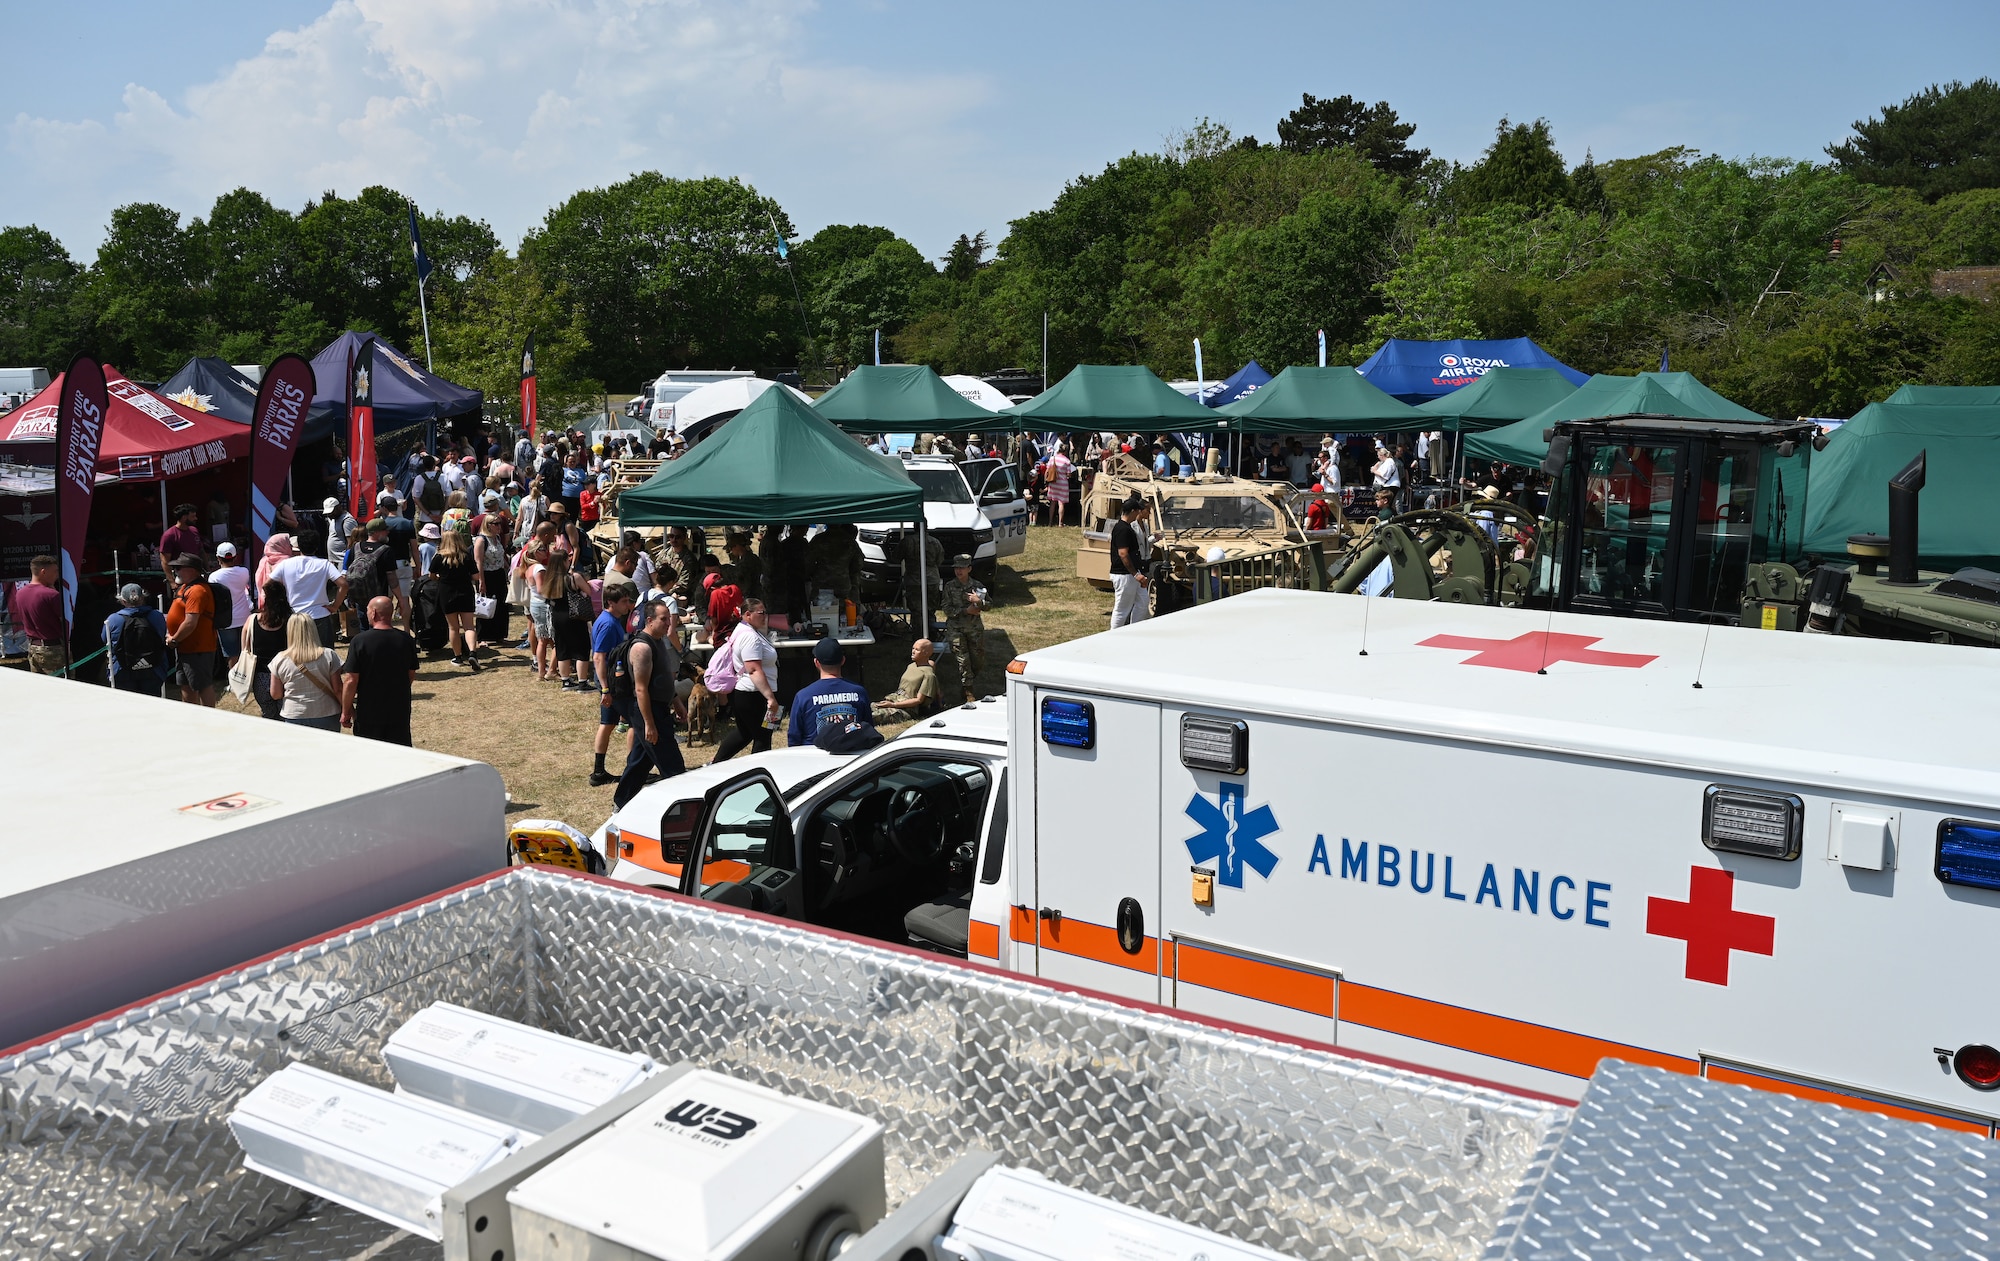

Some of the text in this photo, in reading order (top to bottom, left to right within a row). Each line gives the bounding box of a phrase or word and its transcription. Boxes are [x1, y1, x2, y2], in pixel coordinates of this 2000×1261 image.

[1439, 366, 1492, 378] AIR FOR
[1461, 357, 1510, 367] ROYAL
[1431, 376, 1479, 386] Engin
[259, 378, 287, 440] SUPPORT OUR
[268, 384, 305, 450] PARAS
[65, 389, 84, 480] SUPPORT OUR
[75, 398, 101, 495] PARAS
[192, 444, 209, 466] OUR
[812, 692, 859, 705] PARAMEDIC
[1307, 833, 1612, 928] AMBULANCE
[654, 1121, 731, 1149] WILL-BURT
